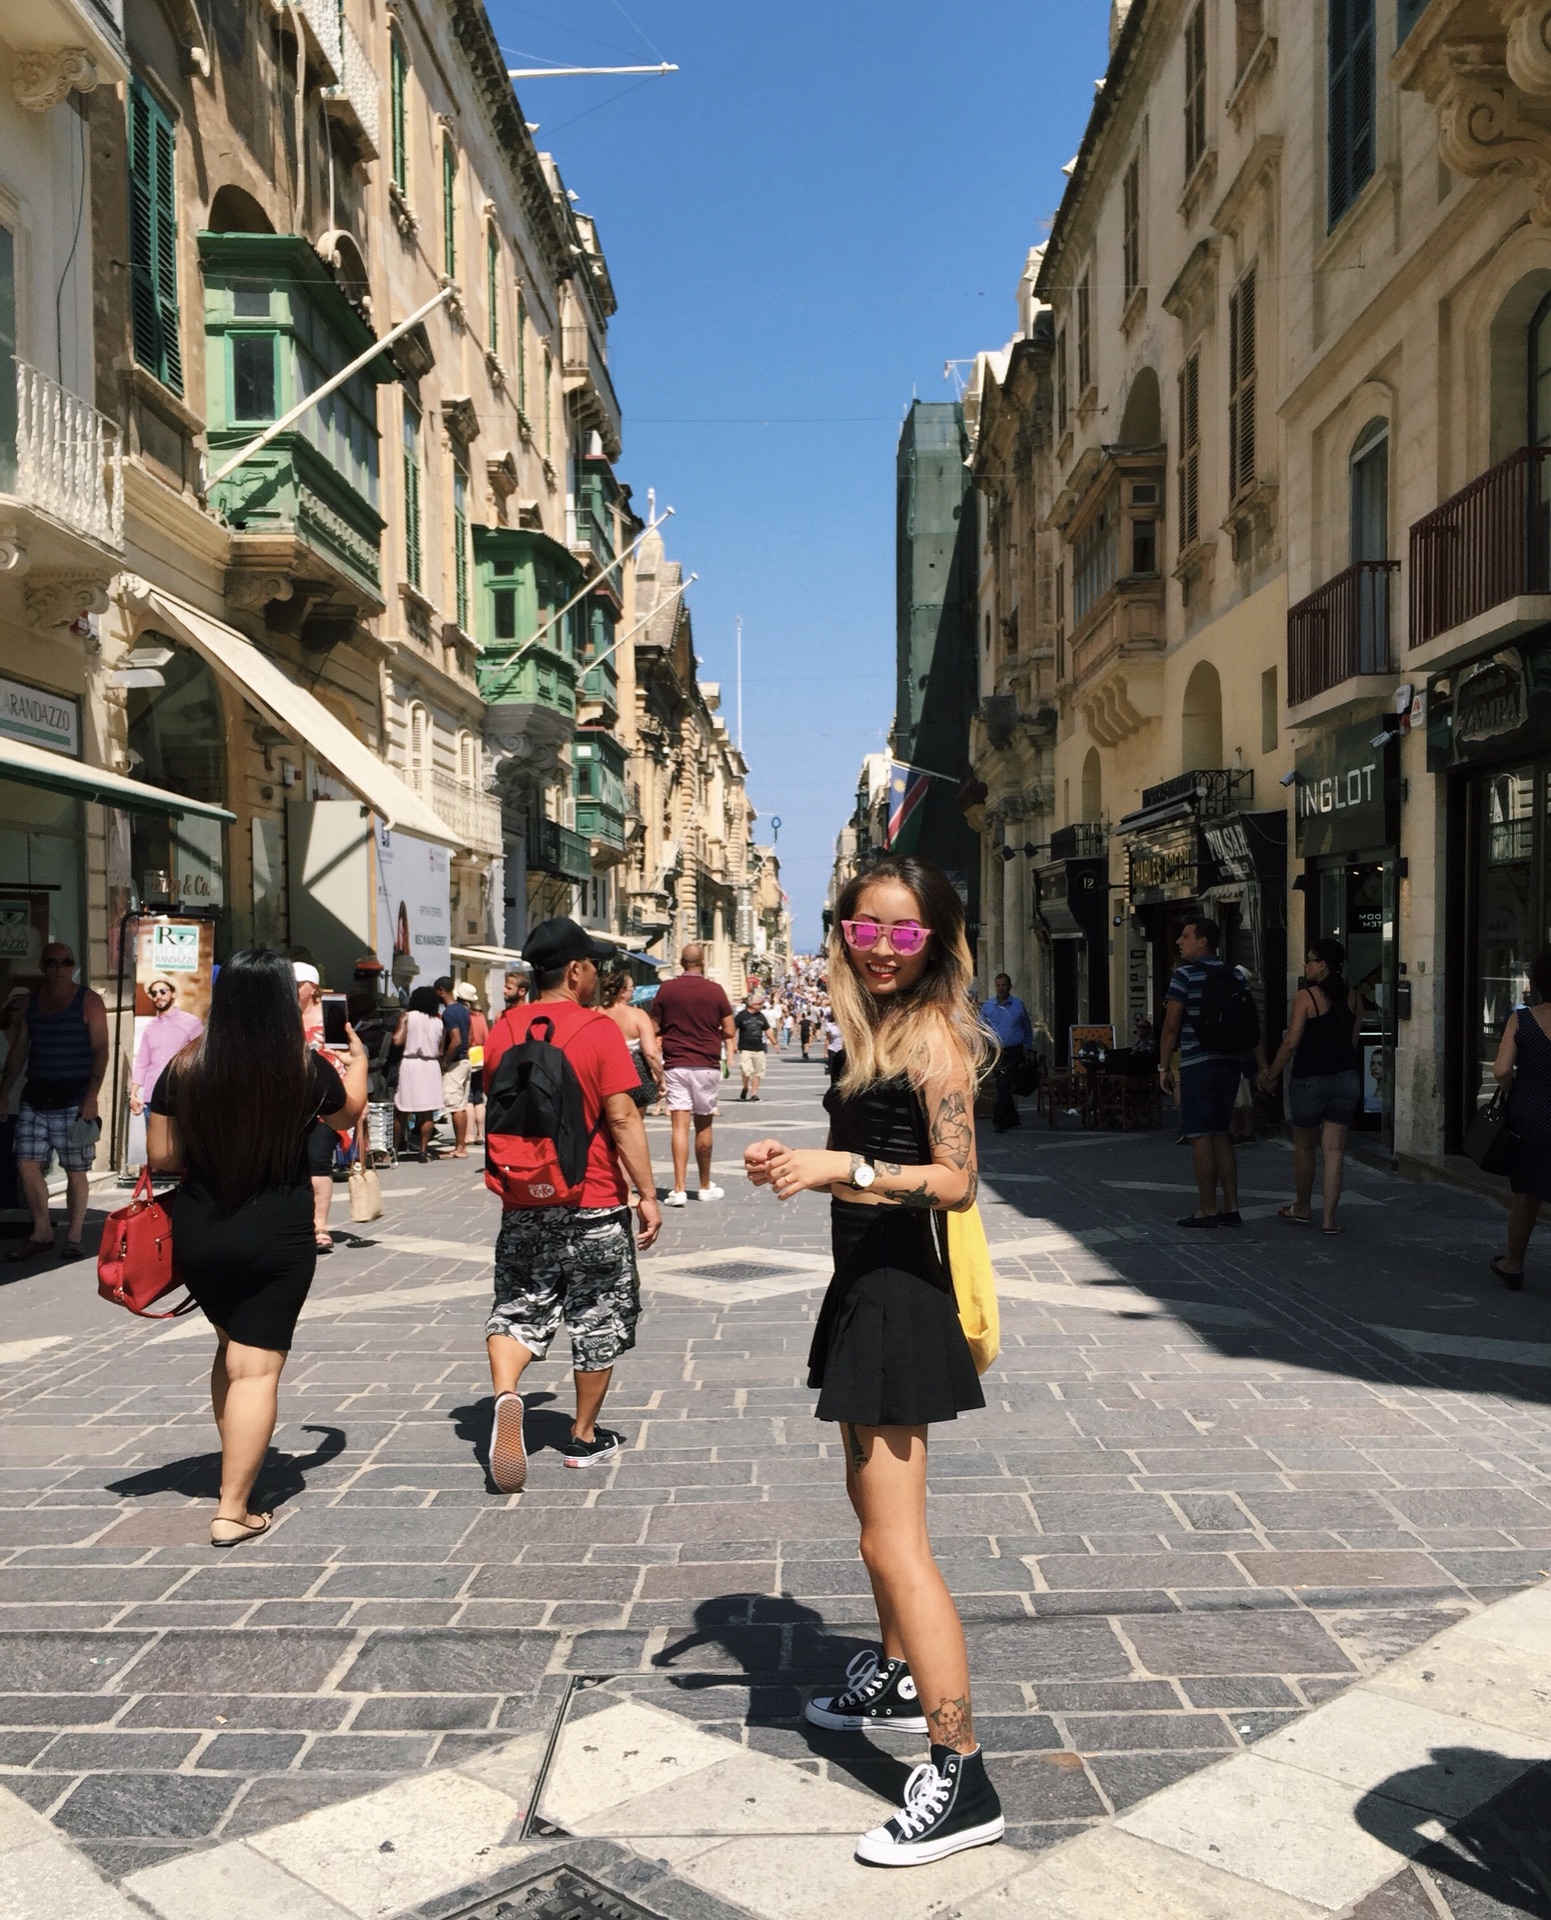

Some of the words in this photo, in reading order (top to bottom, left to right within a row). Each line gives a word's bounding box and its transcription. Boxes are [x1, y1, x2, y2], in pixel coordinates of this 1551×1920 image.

[10, 693, 71, 731] RANDAZZO
[1300, 763, 1376, 818] INGLOT
[1204, 824, 1249, 861] PULSAR
[1083, 877, 1095, 889] 12
[742, 890, 750, 945] Archaeology
[155, 955, 197, 965] RANDAZZO
